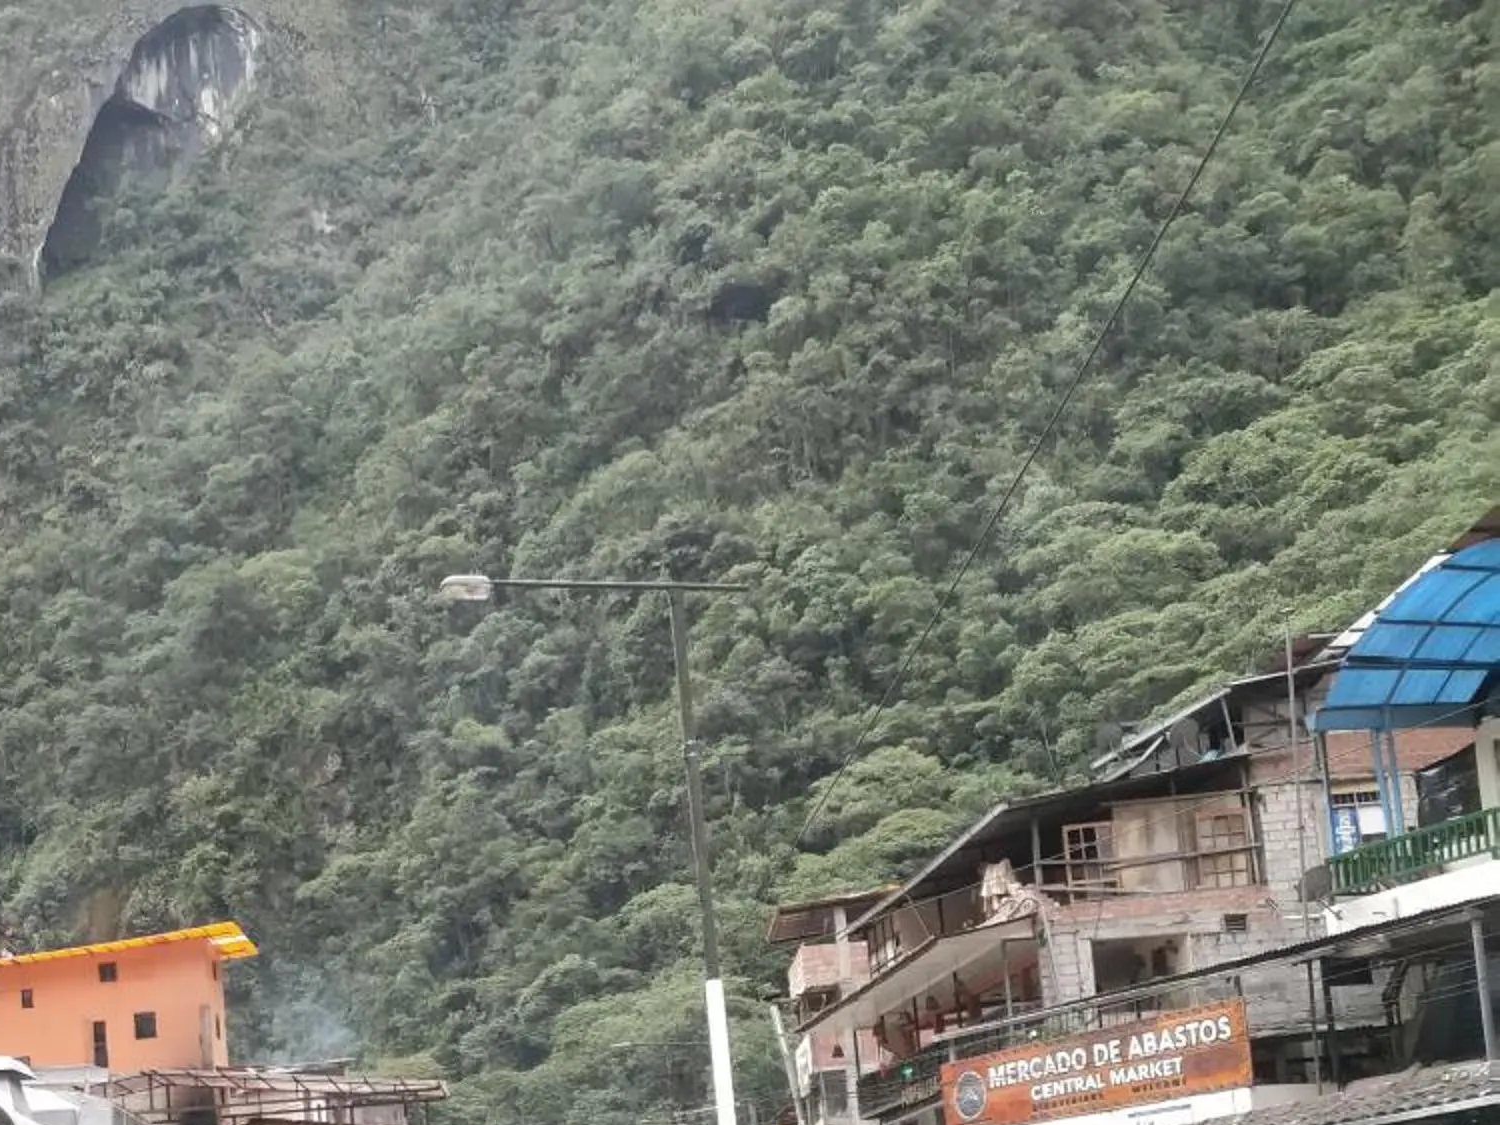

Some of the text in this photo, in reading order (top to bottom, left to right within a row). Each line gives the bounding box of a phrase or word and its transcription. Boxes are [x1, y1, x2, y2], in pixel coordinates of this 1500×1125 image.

[987, 1015, 1232, 1089] MERCADO DE ABASTOS
[1030, 1072, 1107, 1102] CENTRAL
[1109, 1056, 1184, 1086] MARKET
